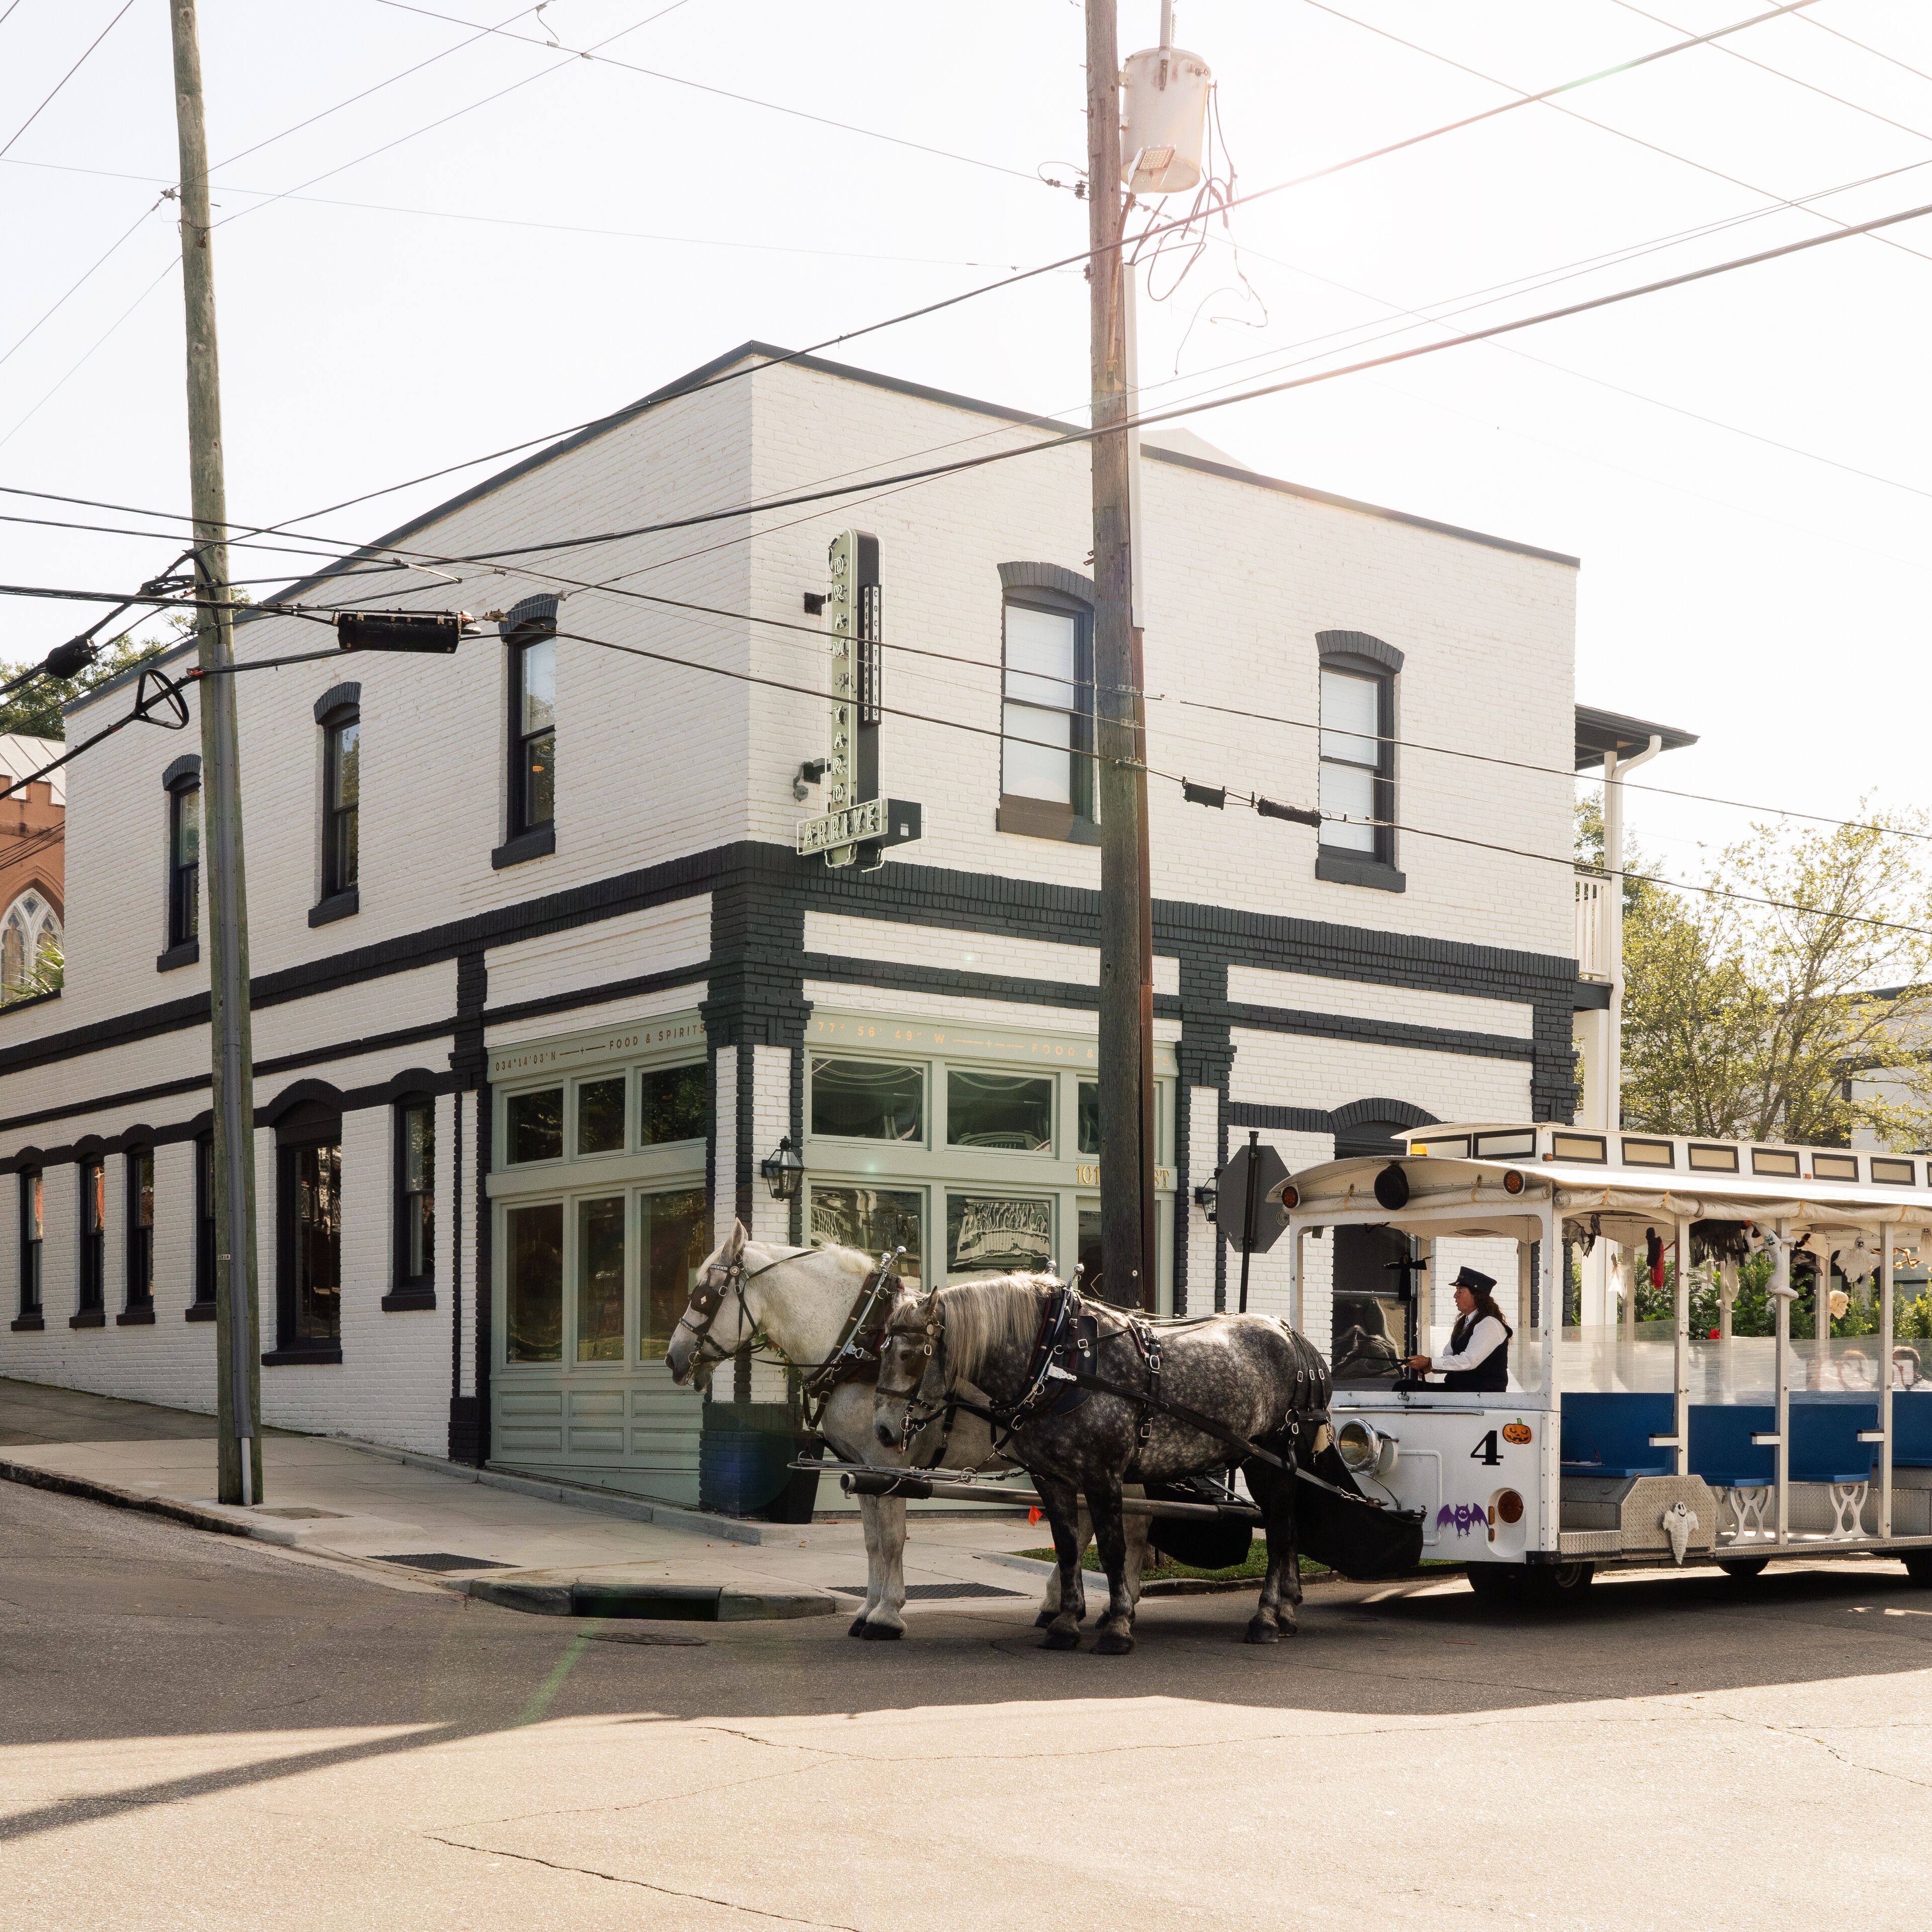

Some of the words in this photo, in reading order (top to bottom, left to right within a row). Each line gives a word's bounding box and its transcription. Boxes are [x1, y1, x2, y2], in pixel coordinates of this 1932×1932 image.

[832, 556, 848, 658] DRAM
[833, 705, 848, 803] YARD
[803, 805, 875, 847] ARRIVE
[610, 1035, 638, 1050] FOOD
[646, 1033, 651, 1043] &
[659, 1023, 705, 1041] SPIRITS
[934, 1033, 945, 1044] W
[1032, 1043, 1075, 1056] FOOD
[1087, 1049, 1094, 1058] &
[1076, 1164, 1099, 1185] 101
[1470, 1430, 1504, 1466] 4
